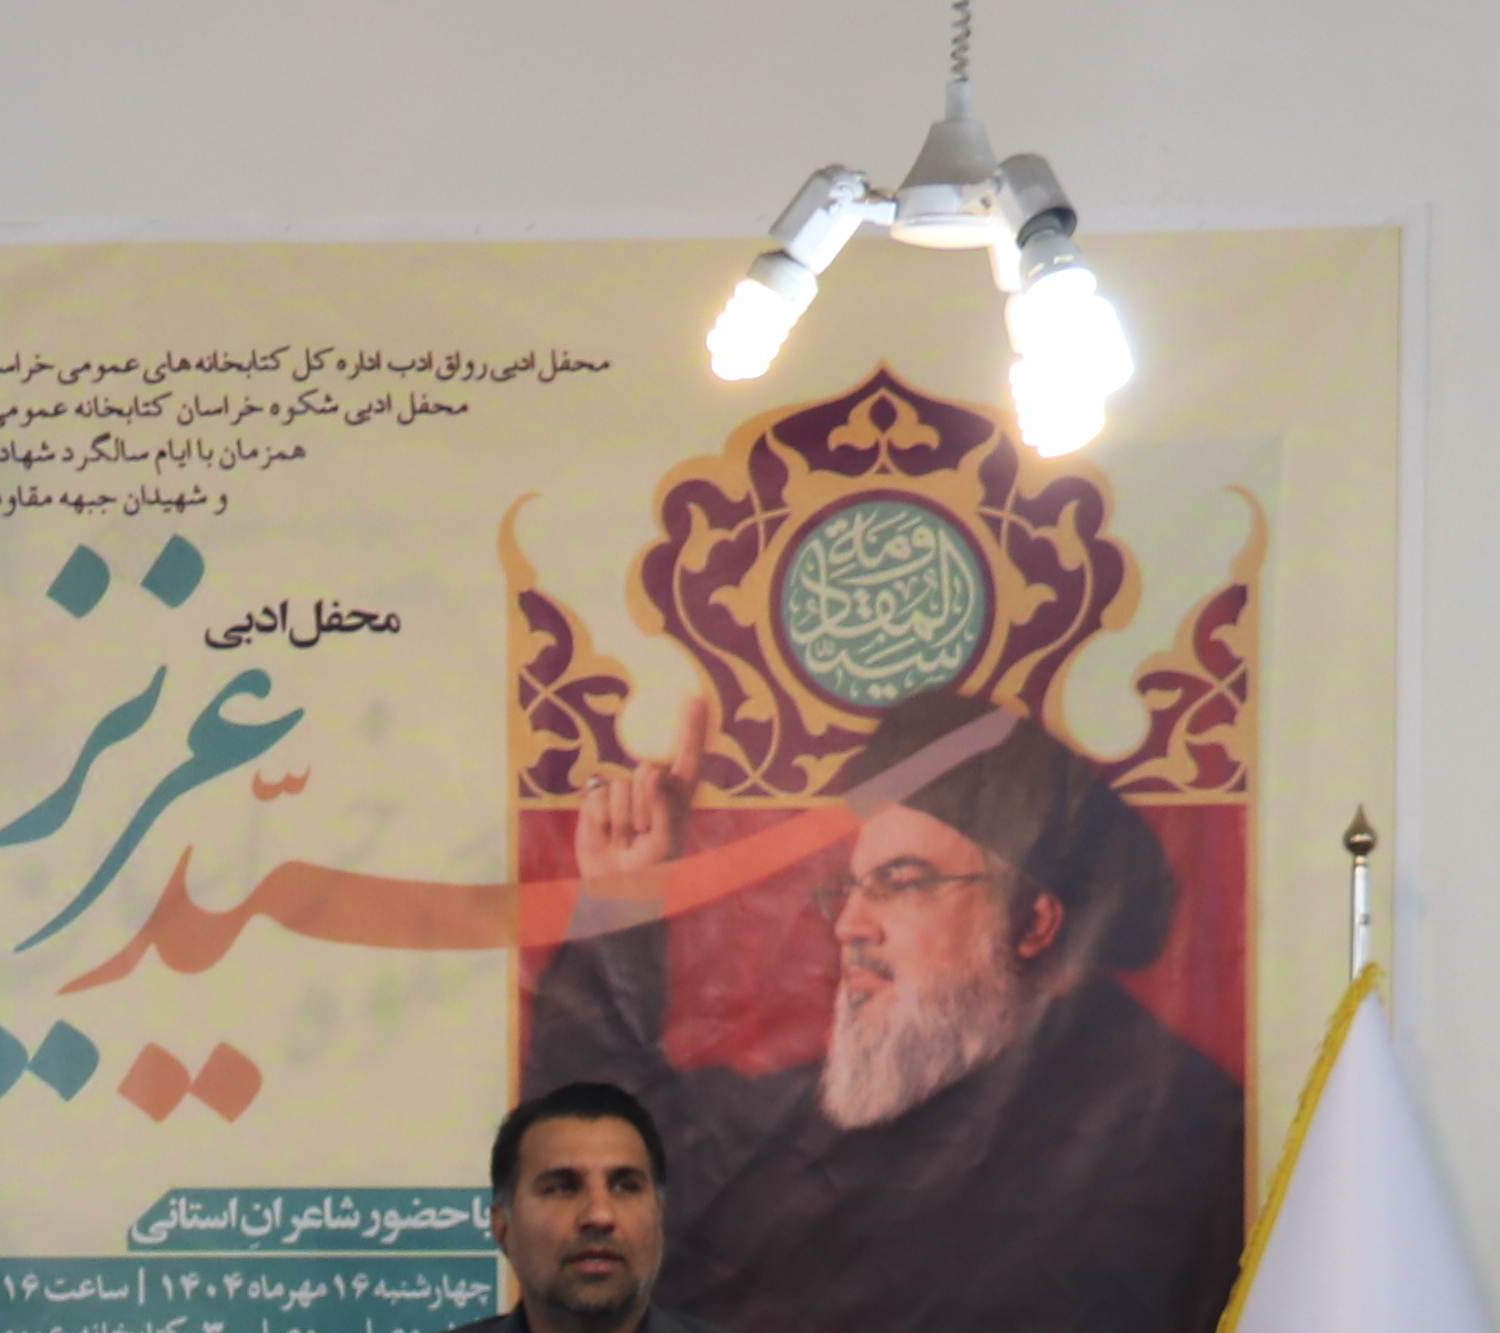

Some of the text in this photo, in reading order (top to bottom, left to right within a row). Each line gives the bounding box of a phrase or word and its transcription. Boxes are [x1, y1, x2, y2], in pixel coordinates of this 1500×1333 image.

[57, 357, 139, 386] عمومی
[292, 346, 334, 383] کل
[336, 350, 382, 381] اداره
[387, 350, 433, 379] ادب
[490, 350, 535, 384] ادبی
[538, 349, 610, 385] محفل
[74, 391, 172, 425] کتابخانه
[177, 394, 264, 427] خراسان
[270, 387, 339, 427] شکوه
[344, 392, 392, 427] ادبی
[397, 391, 469, 427] محفل
[62, 431, 149, 472] سالگرد
[155, 438, 191, 476] ایام
[197, 438, 213, 468] با
[219, 437, 306, 471] همزمان
[59, 491, 117, 515] جبهه
[123, 484, 207, 518] شهیدان
[214, 492, 228, 516] و
[204, 598, 401, 649] محفل ادبی
[132, 1196, 239, 1244] استانی
[4, 1273, 39, 1301] ۱۶
[43, 1274, 129, 1302] ساعت
[161, 1271, 244, 1300] ۱۴۰۴
[334, 1272, 370, 1300] ۱۶
[373, 1273, 492, 1311] چهارشنبه
